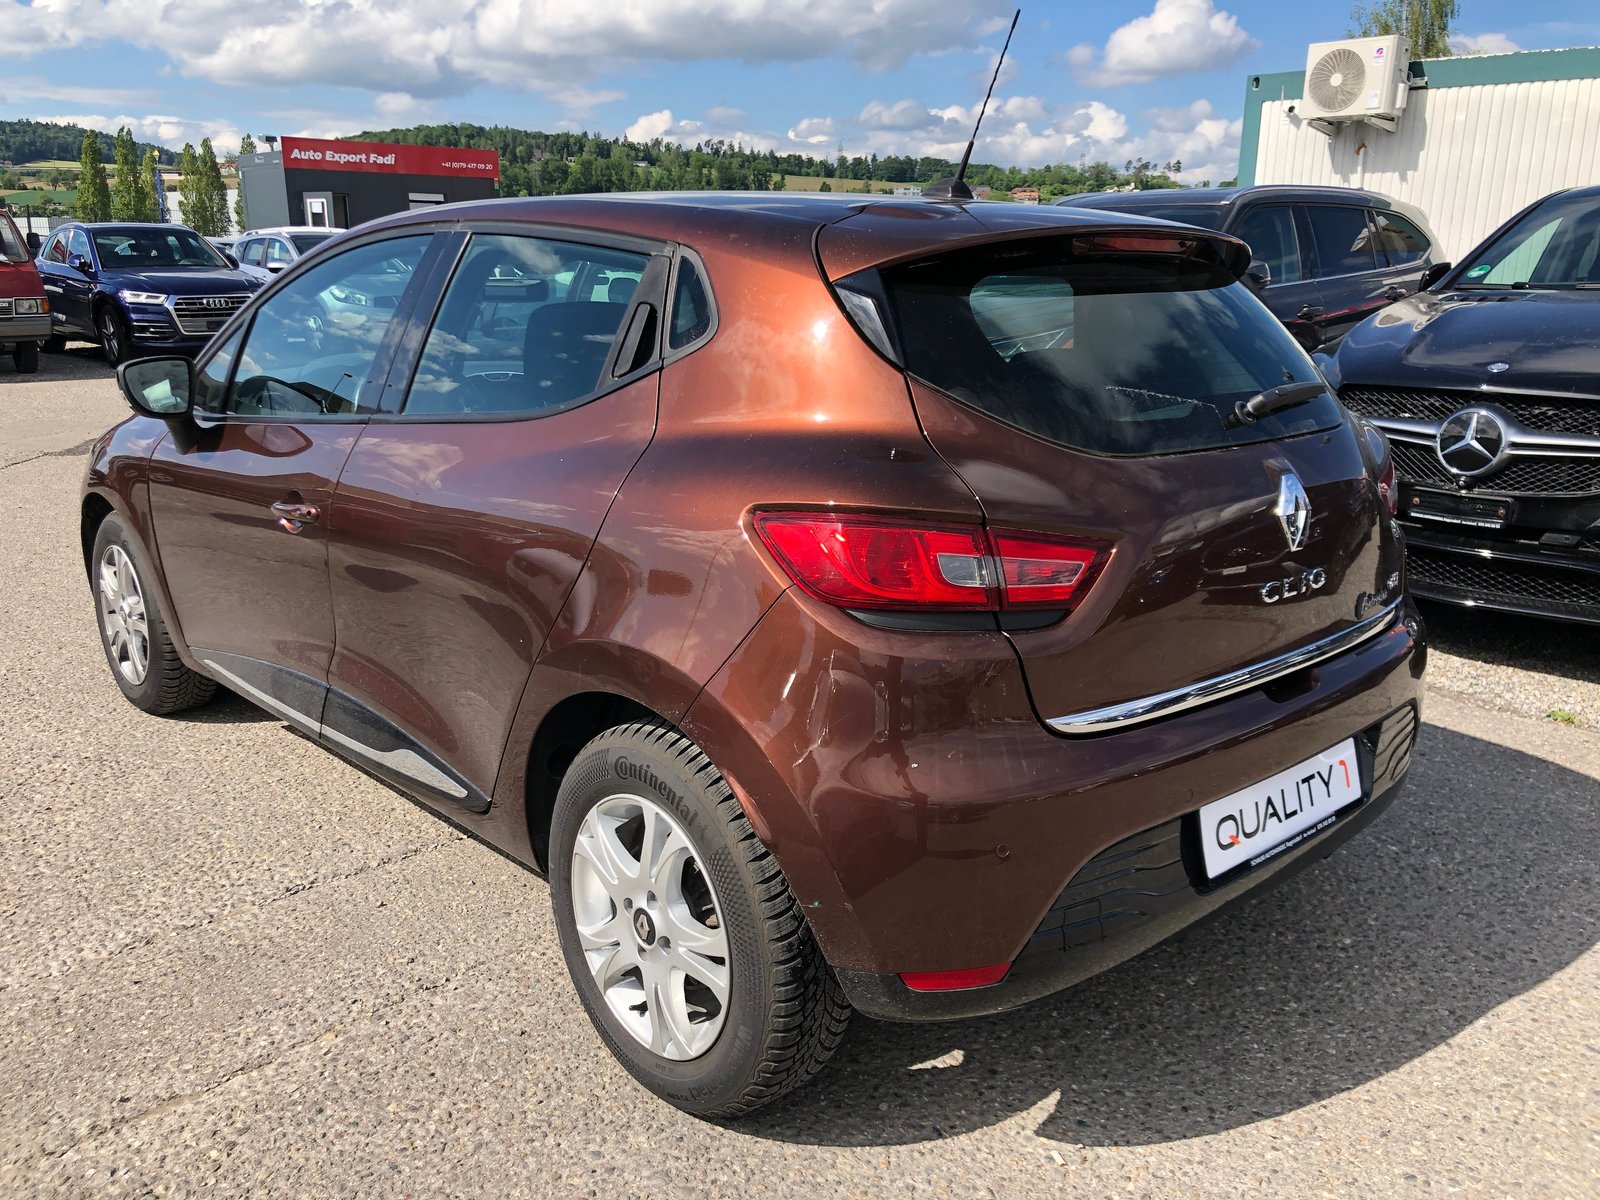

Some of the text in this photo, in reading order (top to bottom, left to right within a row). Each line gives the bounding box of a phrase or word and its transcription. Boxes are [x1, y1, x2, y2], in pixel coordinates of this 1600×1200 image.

[290, 148, 396, 165] Auto Export Fadi
[614, 755, 699, 828] Continental
